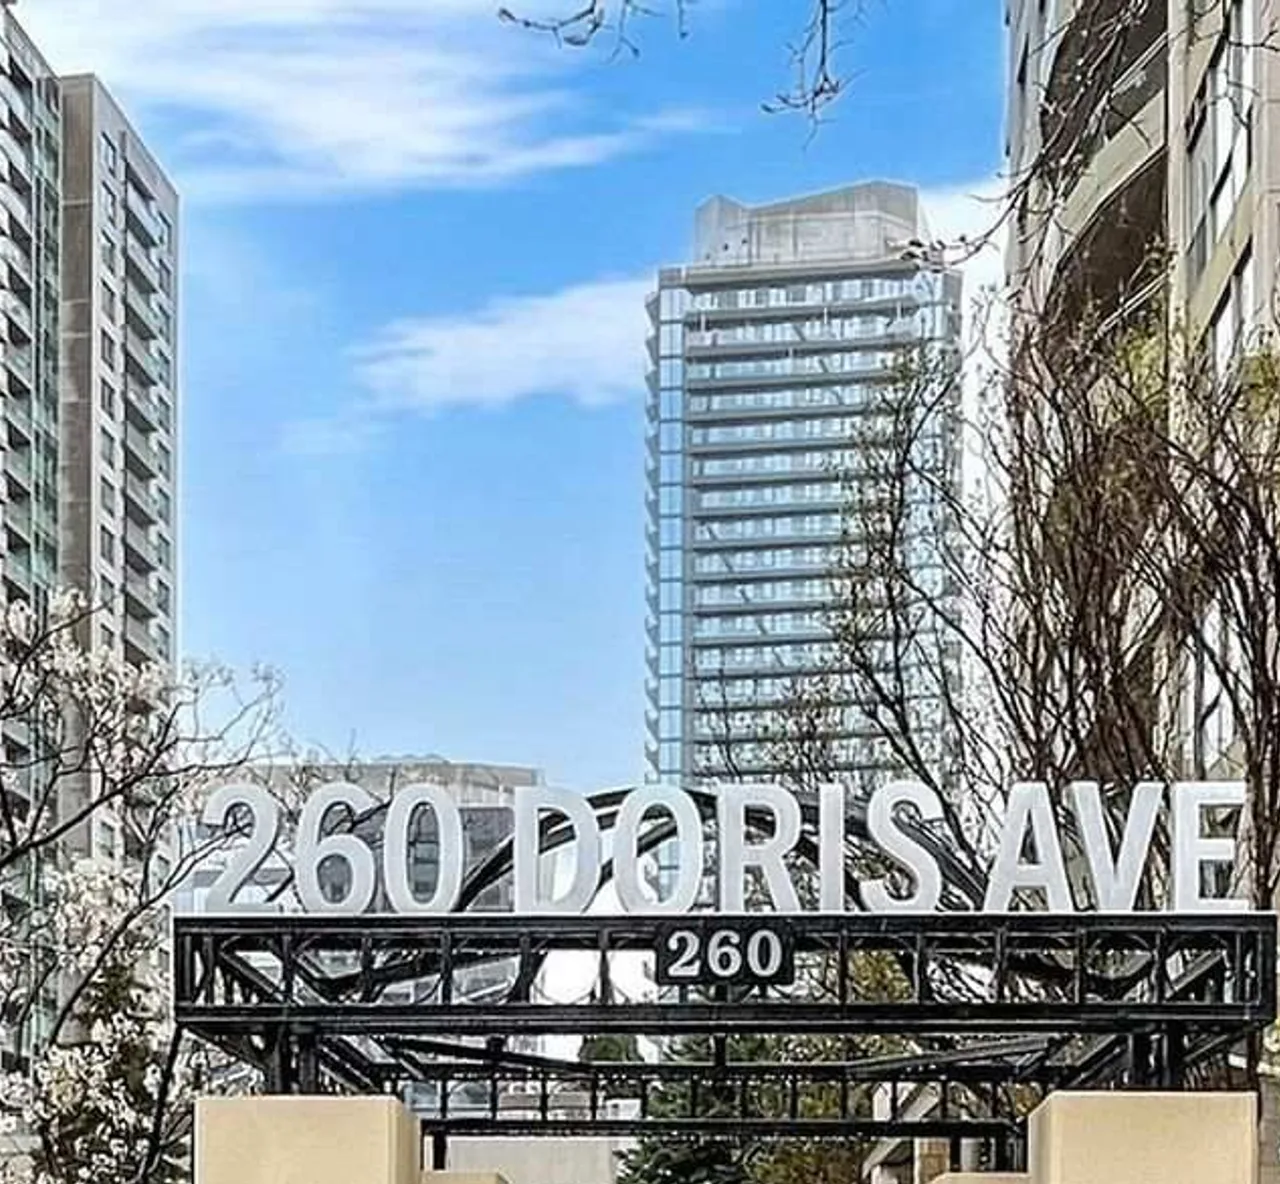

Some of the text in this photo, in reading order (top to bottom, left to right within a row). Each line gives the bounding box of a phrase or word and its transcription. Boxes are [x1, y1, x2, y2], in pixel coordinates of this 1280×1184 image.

[201, 780, 1248, 914] 260 DORIS AVE
[667, 929, 784, 979] 260
